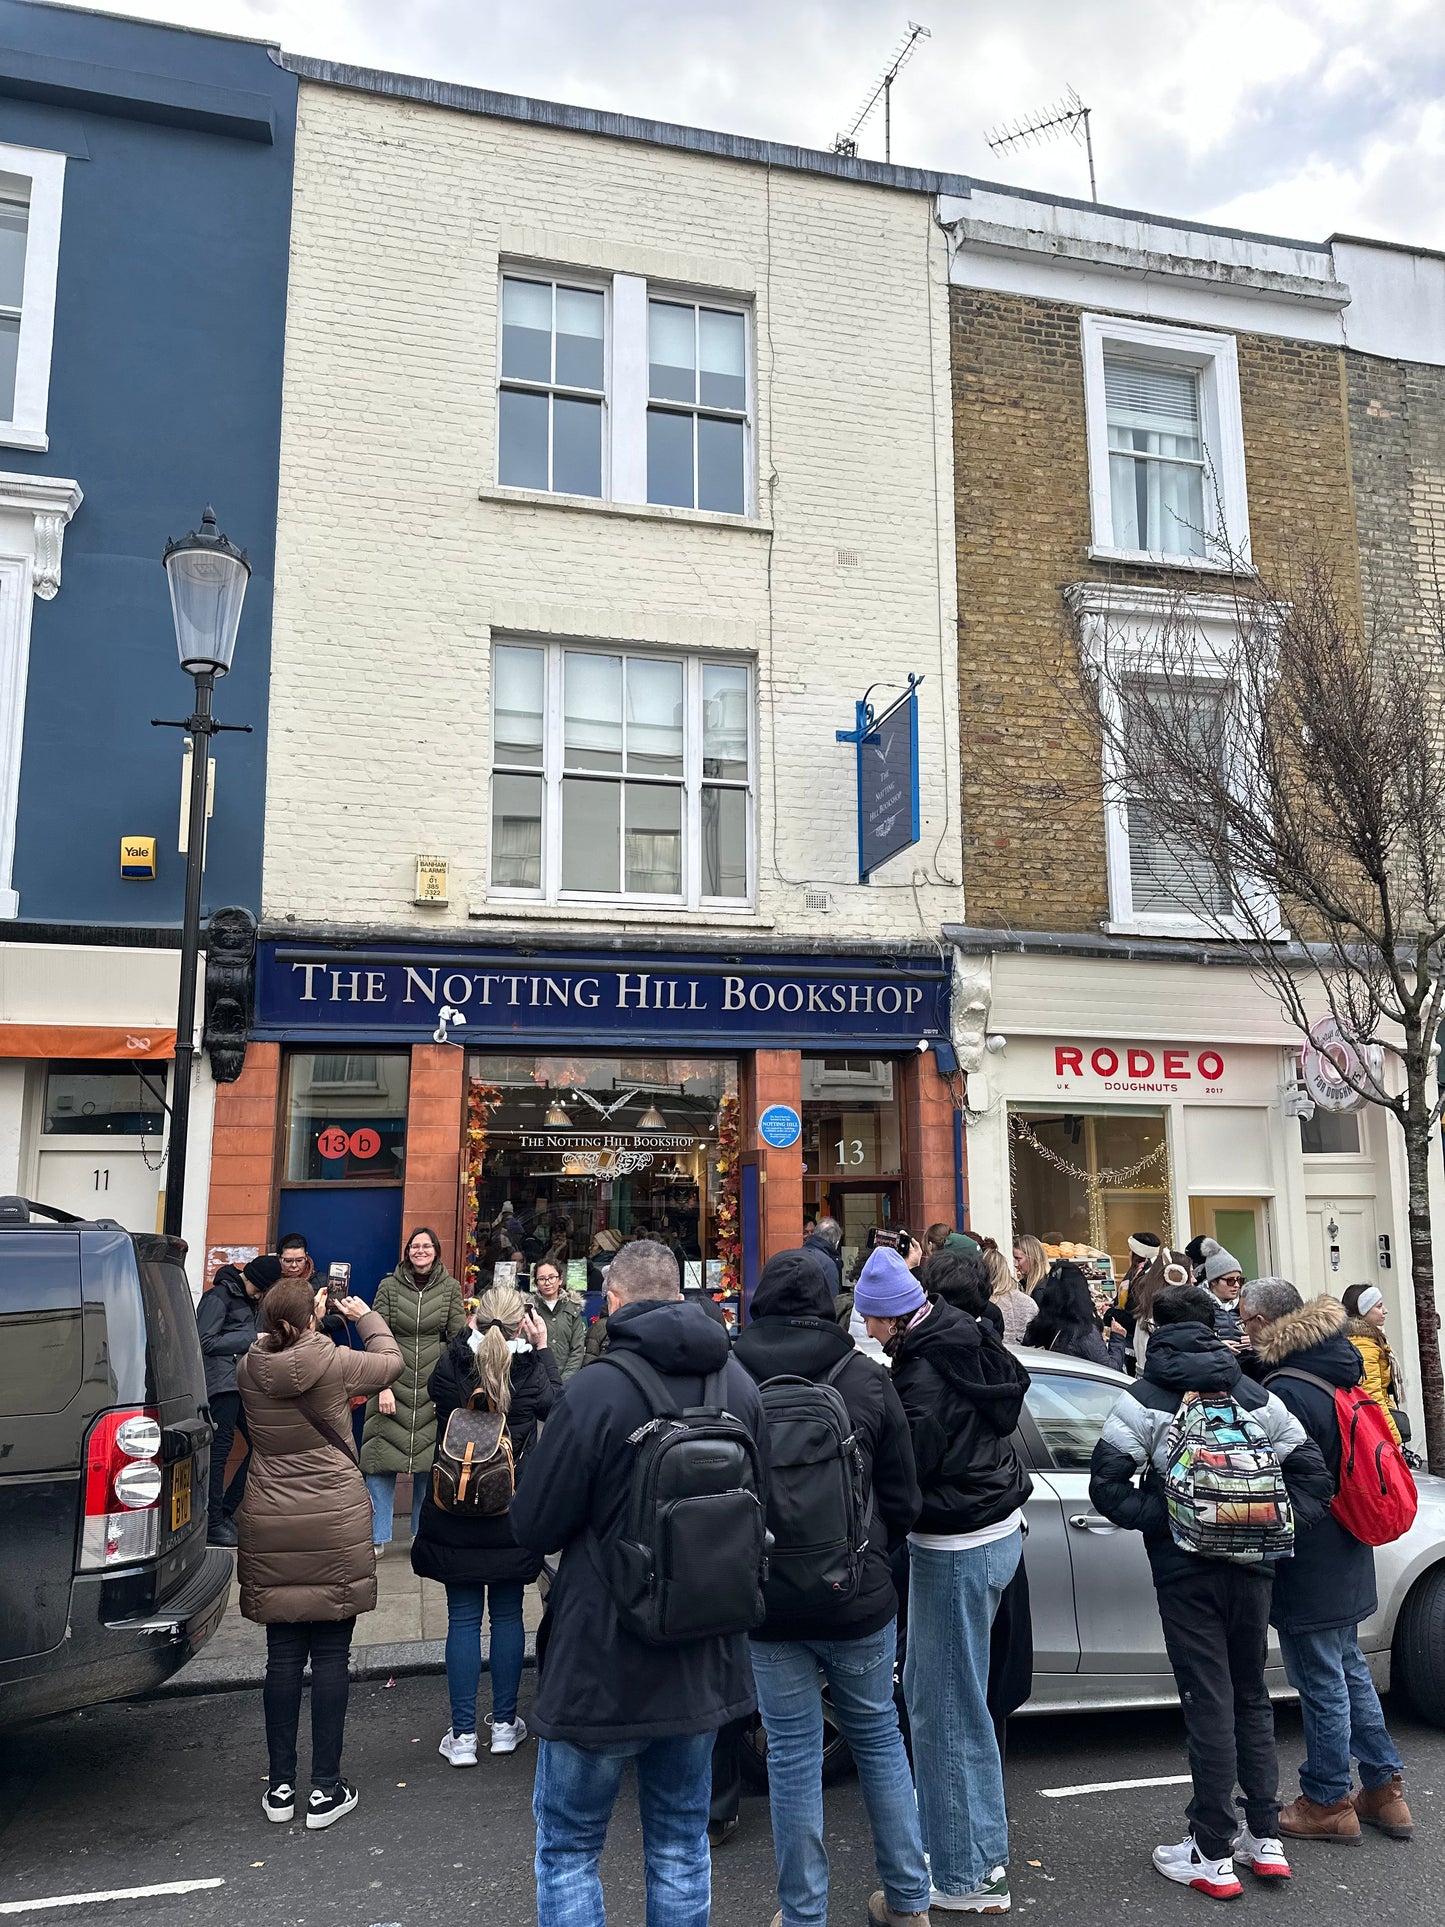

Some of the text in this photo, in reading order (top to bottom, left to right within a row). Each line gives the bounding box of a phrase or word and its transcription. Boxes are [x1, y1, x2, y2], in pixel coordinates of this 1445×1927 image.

[879, 791, 902, 814] BOOKSHOP
[125, 847, 149, 857] Yale
[292, 962, 923, 1014] THE NOTTING HILL BOOKSHOP
[1054, 1046, 1225, 1081] RODEO
[1104, 1082, 1178, 1093] DOUGHNUTS
[519, 1136, 694, 1147] THE NOTTING HILL BOOKSHOP
[834, 1139, 865, 1165] 13
[93, 1169, 109, 1191] 11
